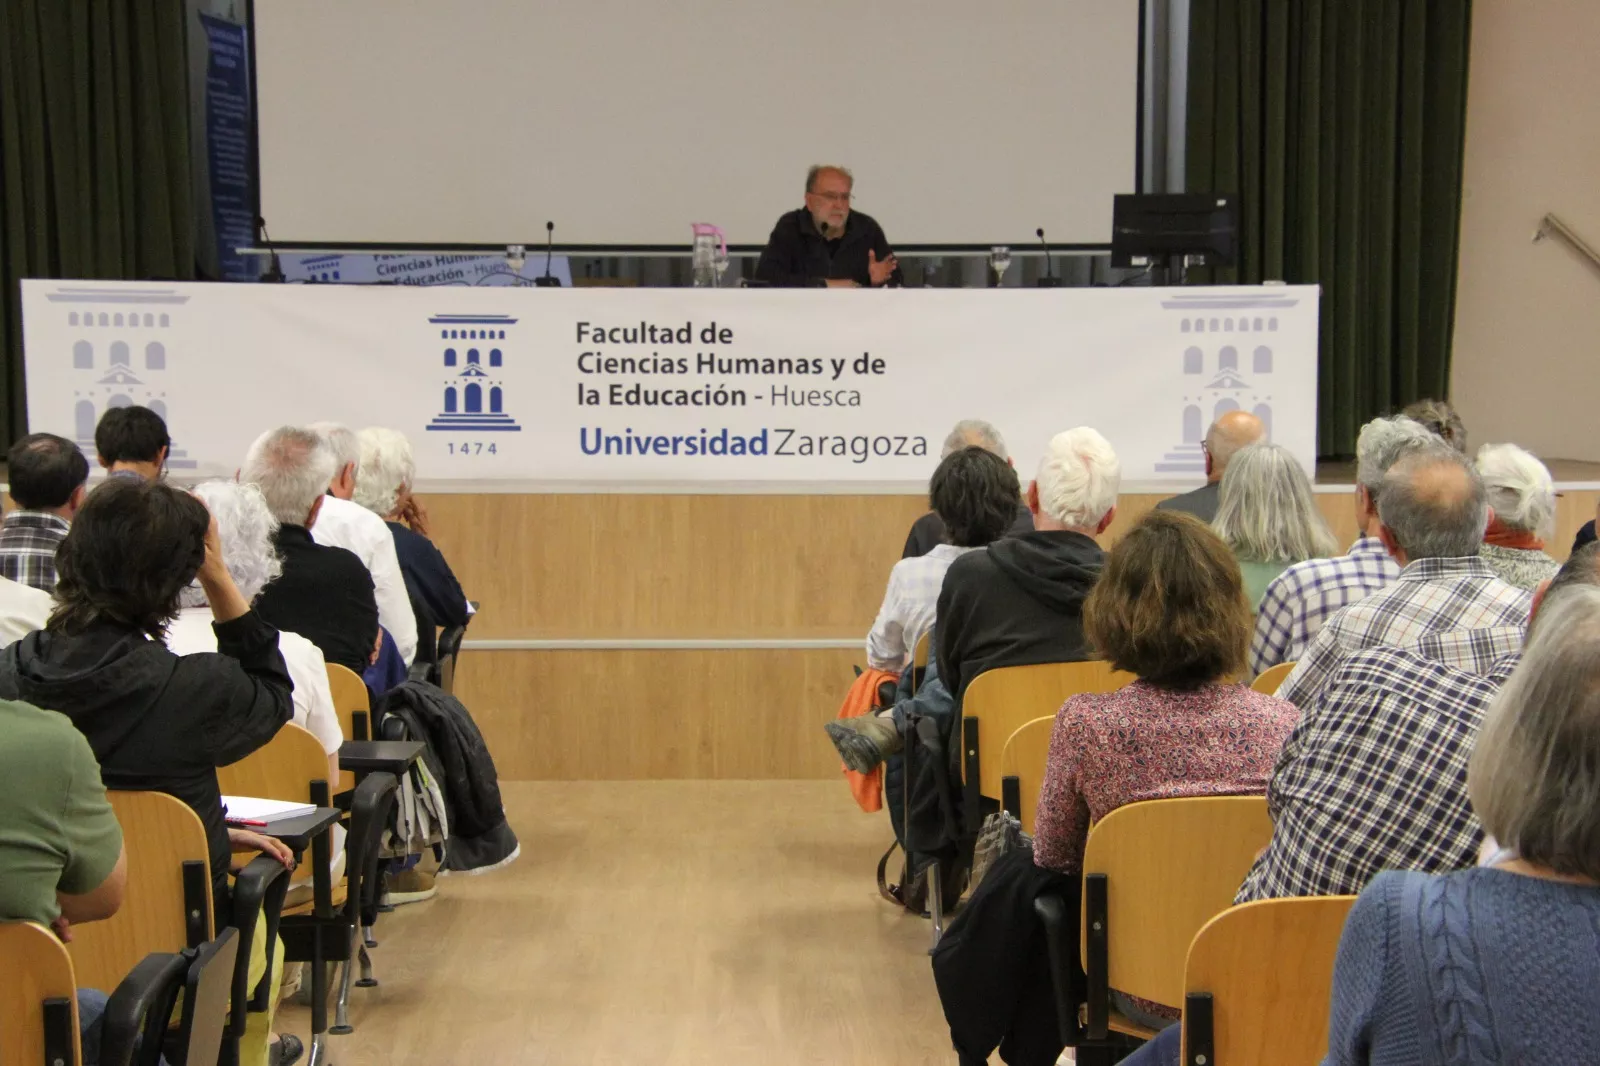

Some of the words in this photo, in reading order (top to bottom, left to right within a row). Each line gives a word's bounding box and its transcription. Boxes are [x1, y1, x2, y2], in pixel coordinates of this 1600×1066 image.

[376, 258, 433, 276] Ciencias
[394, 267, 464, 285] Educación
[577, 321, 692, 345] Facultad
[700, 321, 734, 345] de
[578, 351, 689, 375] Ciencias
[697, 352, 824, 375] Humanas
[831, 358, 845, 381] y
[853, 351, 886, 375] de
[578, 383, 601, 406] la
[609, 383, 747, 407] Educación
[771, 384, 861, 407] Huesca
[447, 442, 498, 455] 1474
[581, 427, 768, 456] Universidad
[774, 428, 927, 464] Zaragoza
